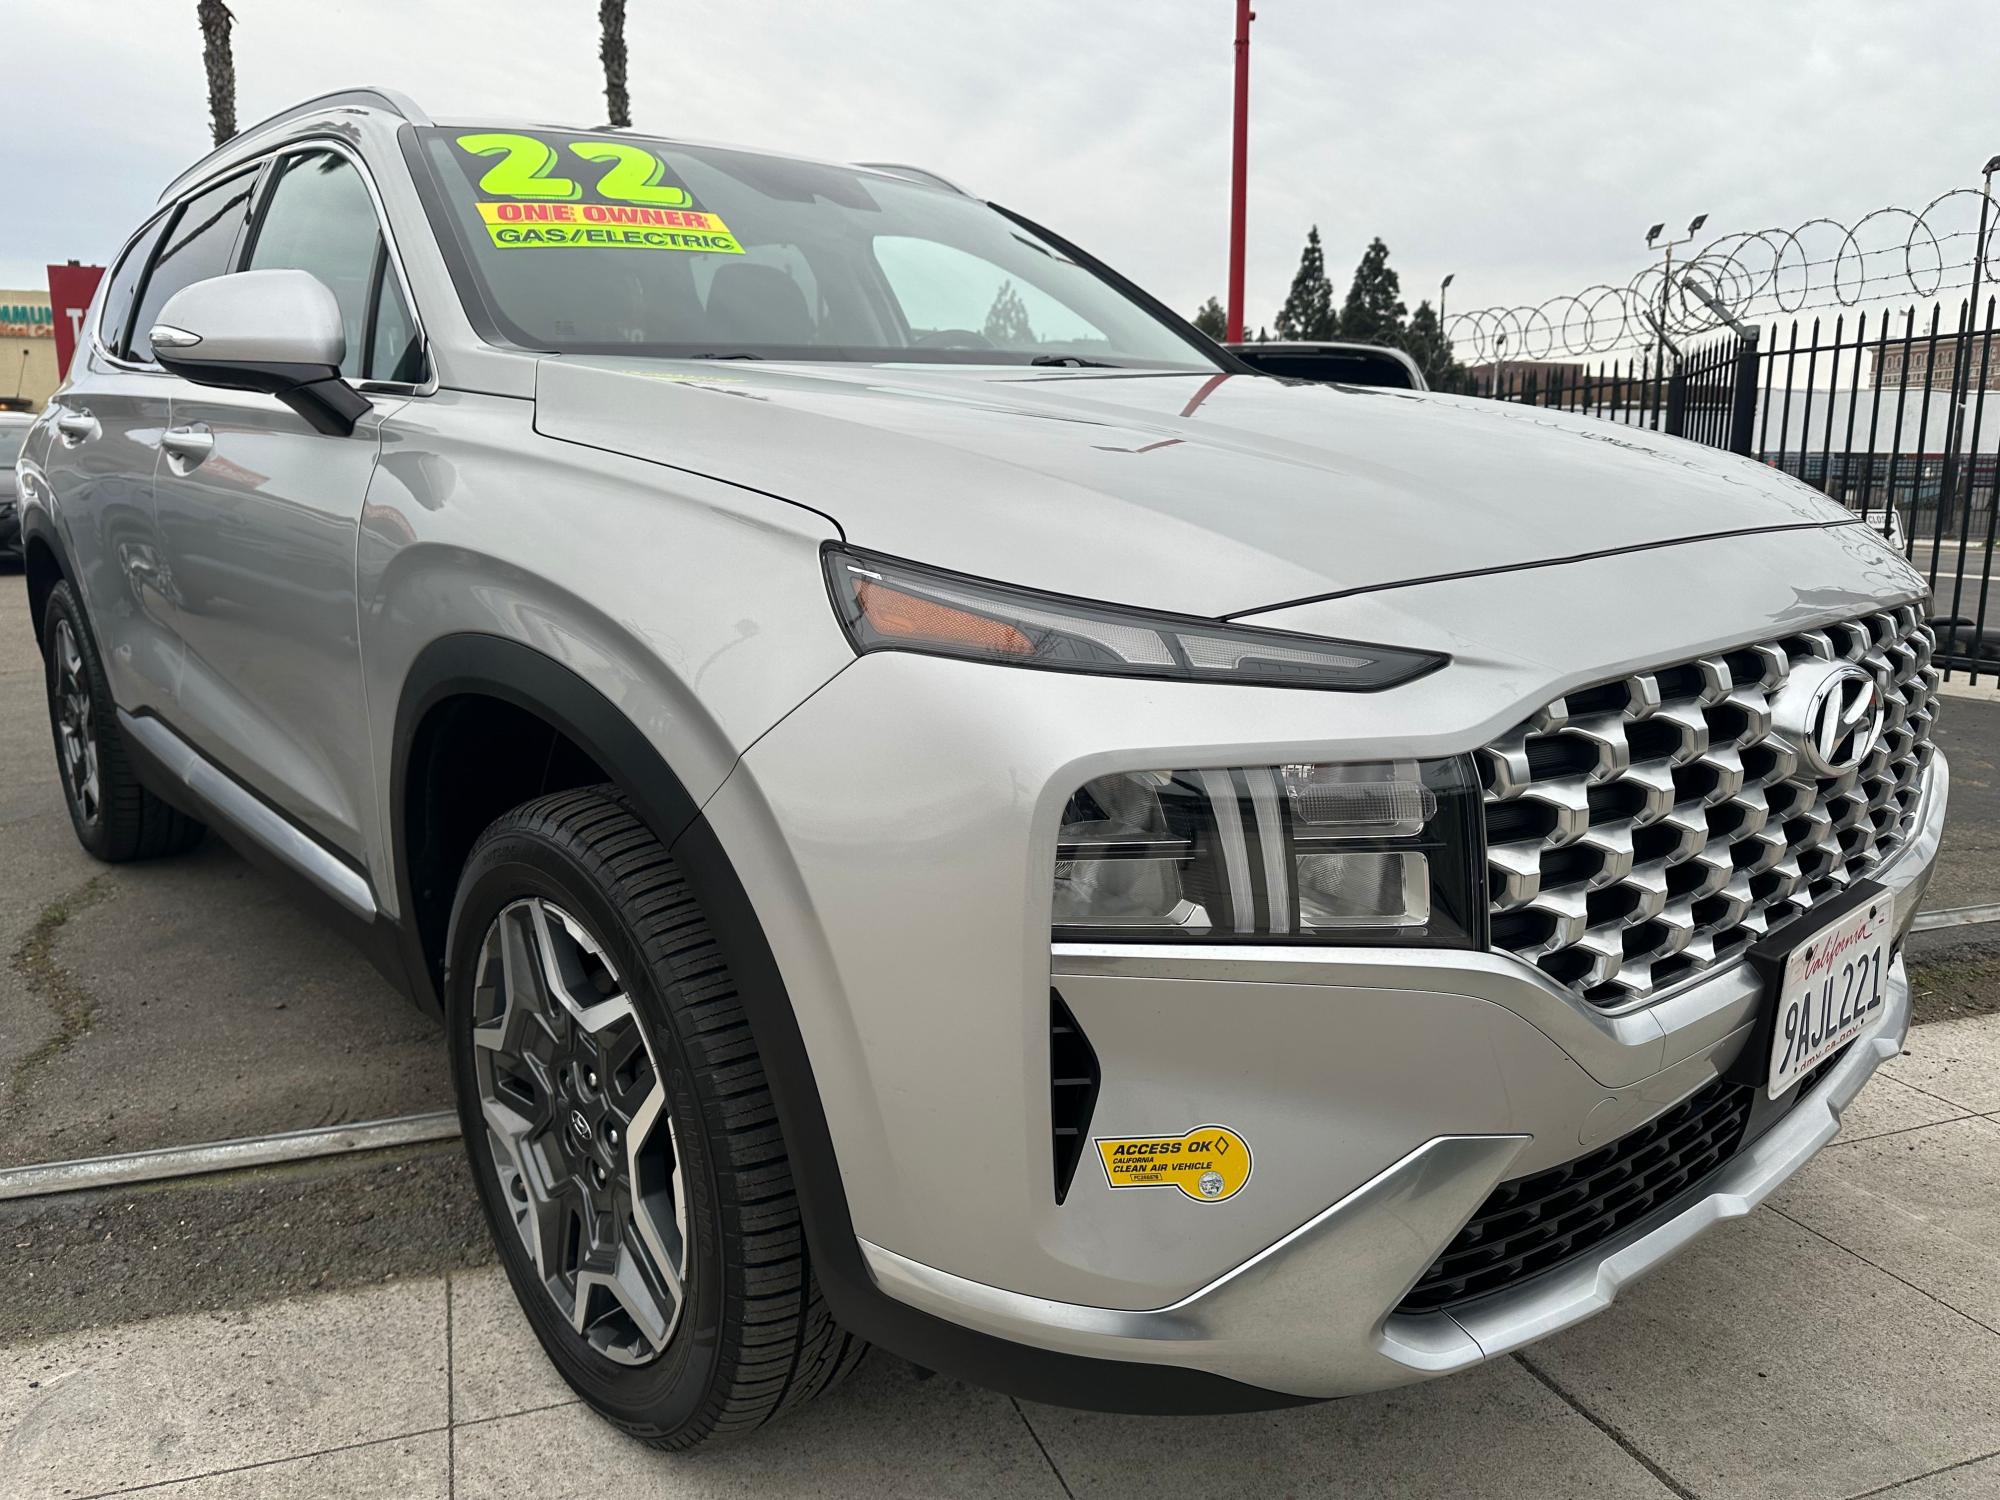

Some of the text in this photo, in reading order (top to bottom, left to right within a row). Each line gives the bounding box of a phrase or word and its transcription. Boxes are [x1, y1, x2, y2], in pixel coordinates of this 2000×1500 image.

[455, 133, 693, 208] 22
[496, 203, 712, 230] ONE OWNER
[495, 228, 734, 250] GAS/ELECTRIC
[1867, 515, 1895, 524] CLOSD
[1804, 919, 1873, 981] California
[1779, 945, 1881, 1074] 9AJL221
[1113, 1141, 1213, 1156] ACCESS OK
[1112, 1157, 1154, 1165] CALIFORNIA
[1113, 1161, 1213, 1173] CLEAN AIR VEHICLE
